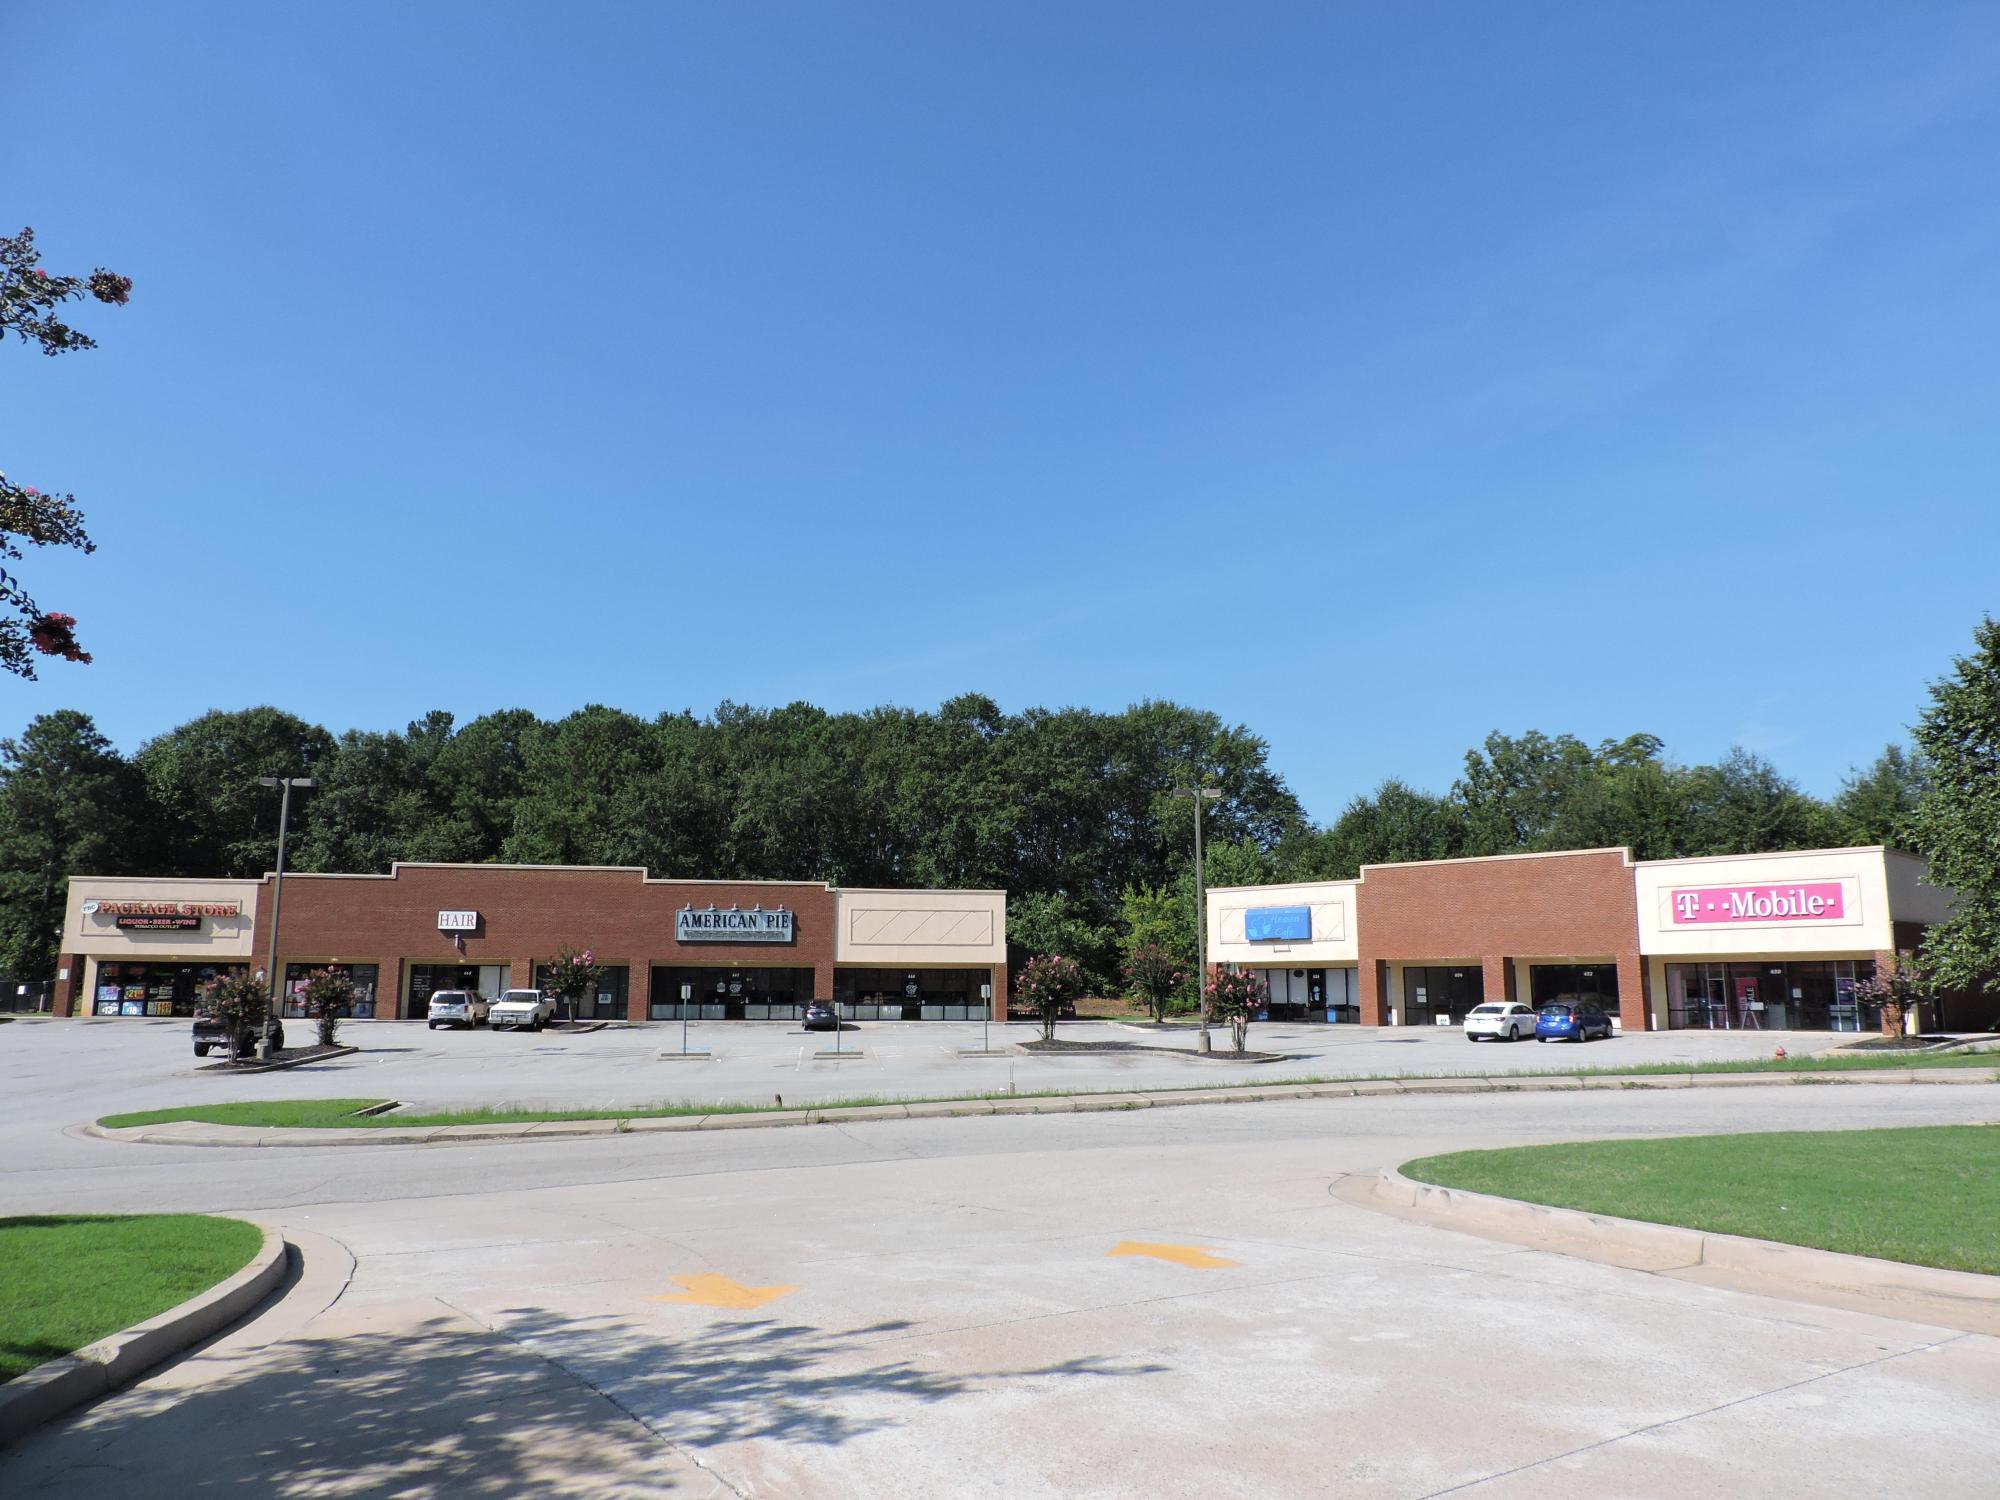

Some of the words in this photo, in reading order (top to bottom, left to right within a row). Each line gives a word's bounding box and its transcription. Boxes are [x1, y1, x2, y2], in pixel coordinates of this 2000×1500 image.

[99, 902, 177, 915] PACKAGE
[182, 903, 238, 917] STORE
[440, 913, 475, 927] HAIR
[680, 914, 757, 928] AMERICAN
[767, 914, 789, 928] PIE
